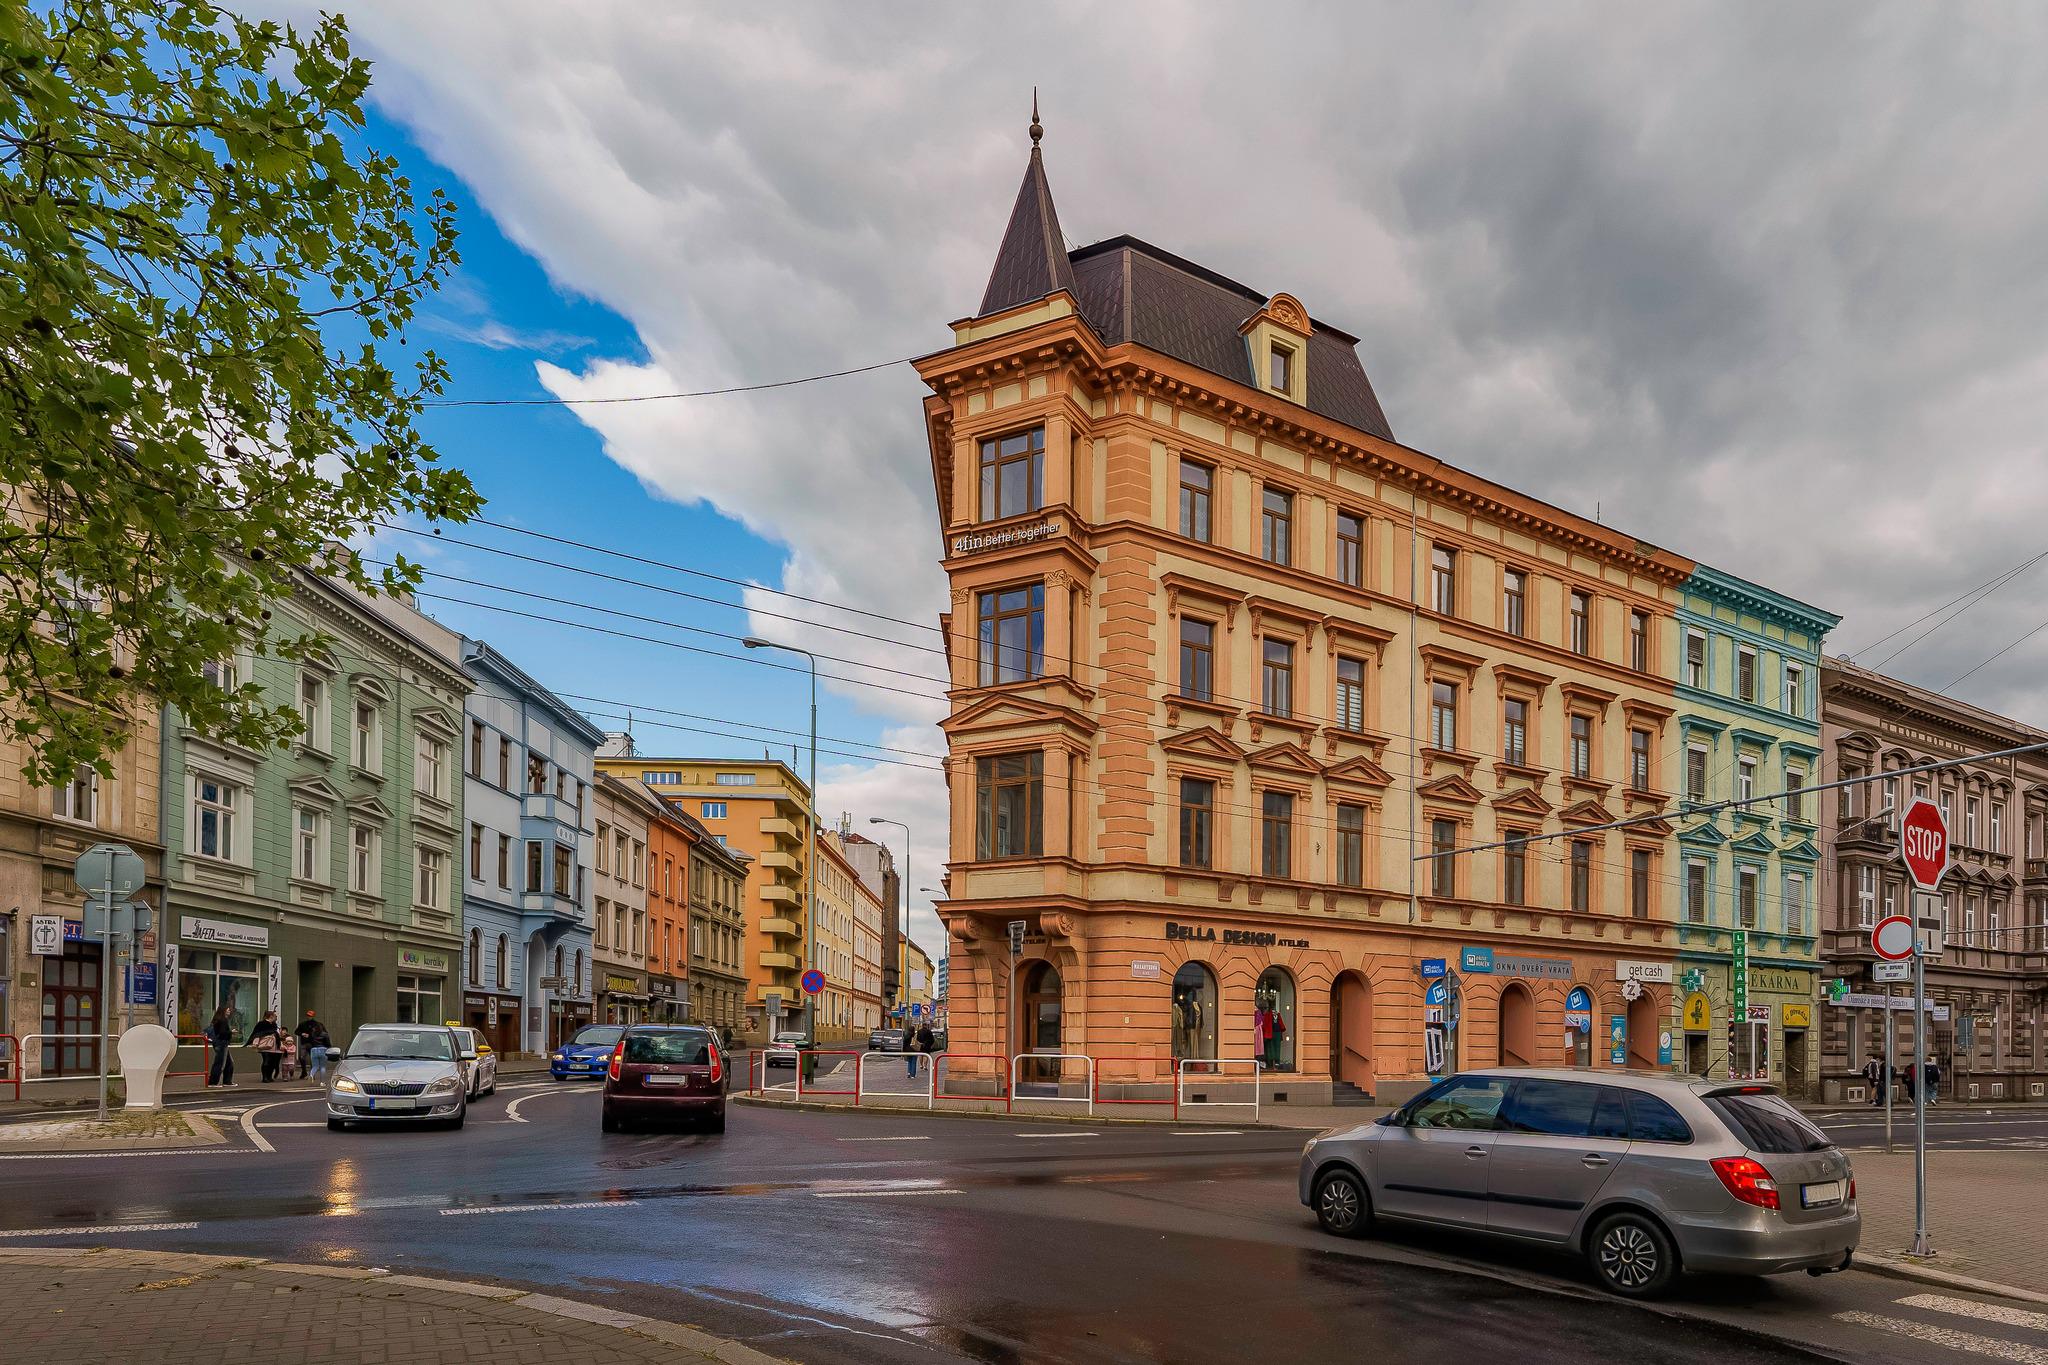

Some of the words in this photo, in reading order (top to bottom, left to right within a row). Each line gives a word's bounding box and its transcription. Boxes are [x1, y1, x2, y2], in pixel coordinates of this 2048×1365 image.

[955, 535, 983, 552] 4fin
[984, 532, 1015, 547] Better
[1017, 523, 1060, 540] together
[1907, 825, 1942, 862] STOP
[1165, 921, 1217, 942] BELLA
[1223, 928, 1277, 947] DESIGN
[1496, 962, 1517, 971] OKNA
[1521, 963, 1544, 973] DVEŘE
[1548, 965, 1570, 975] VRATA
[1629, 965, 1643, 977] get
[1644, 965, 1663, 977] cash
[1736, 934, 1744, 1021] LÉKÁRNA
[1748, 969, 1799, 990] ÉKÁRNA
